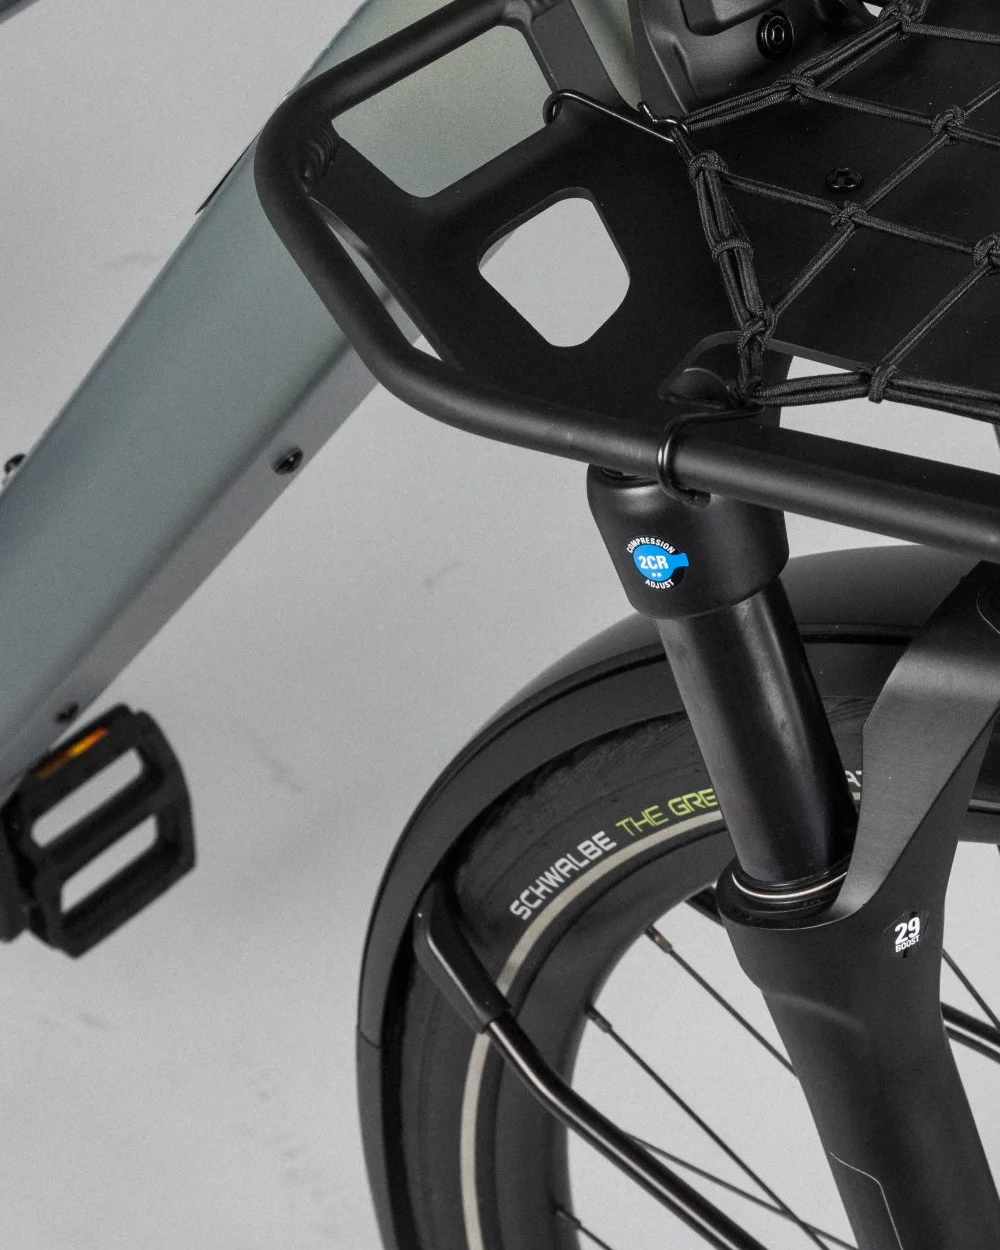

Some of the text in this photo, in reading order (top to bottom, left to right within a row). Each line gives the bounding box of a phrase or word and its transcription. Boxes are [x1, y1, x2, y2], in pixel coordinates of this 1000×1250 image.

[626, 537, 676, 554] COMPRESSION
[638, 555, 669, 570] 2CR
[644, 578, 675, 589] ADJUST
[510, 788, 717, 921] SCHWALBE THE GRE
[894, 916, 920, 945] 29
[895, 934, 920, 953] BOOST
